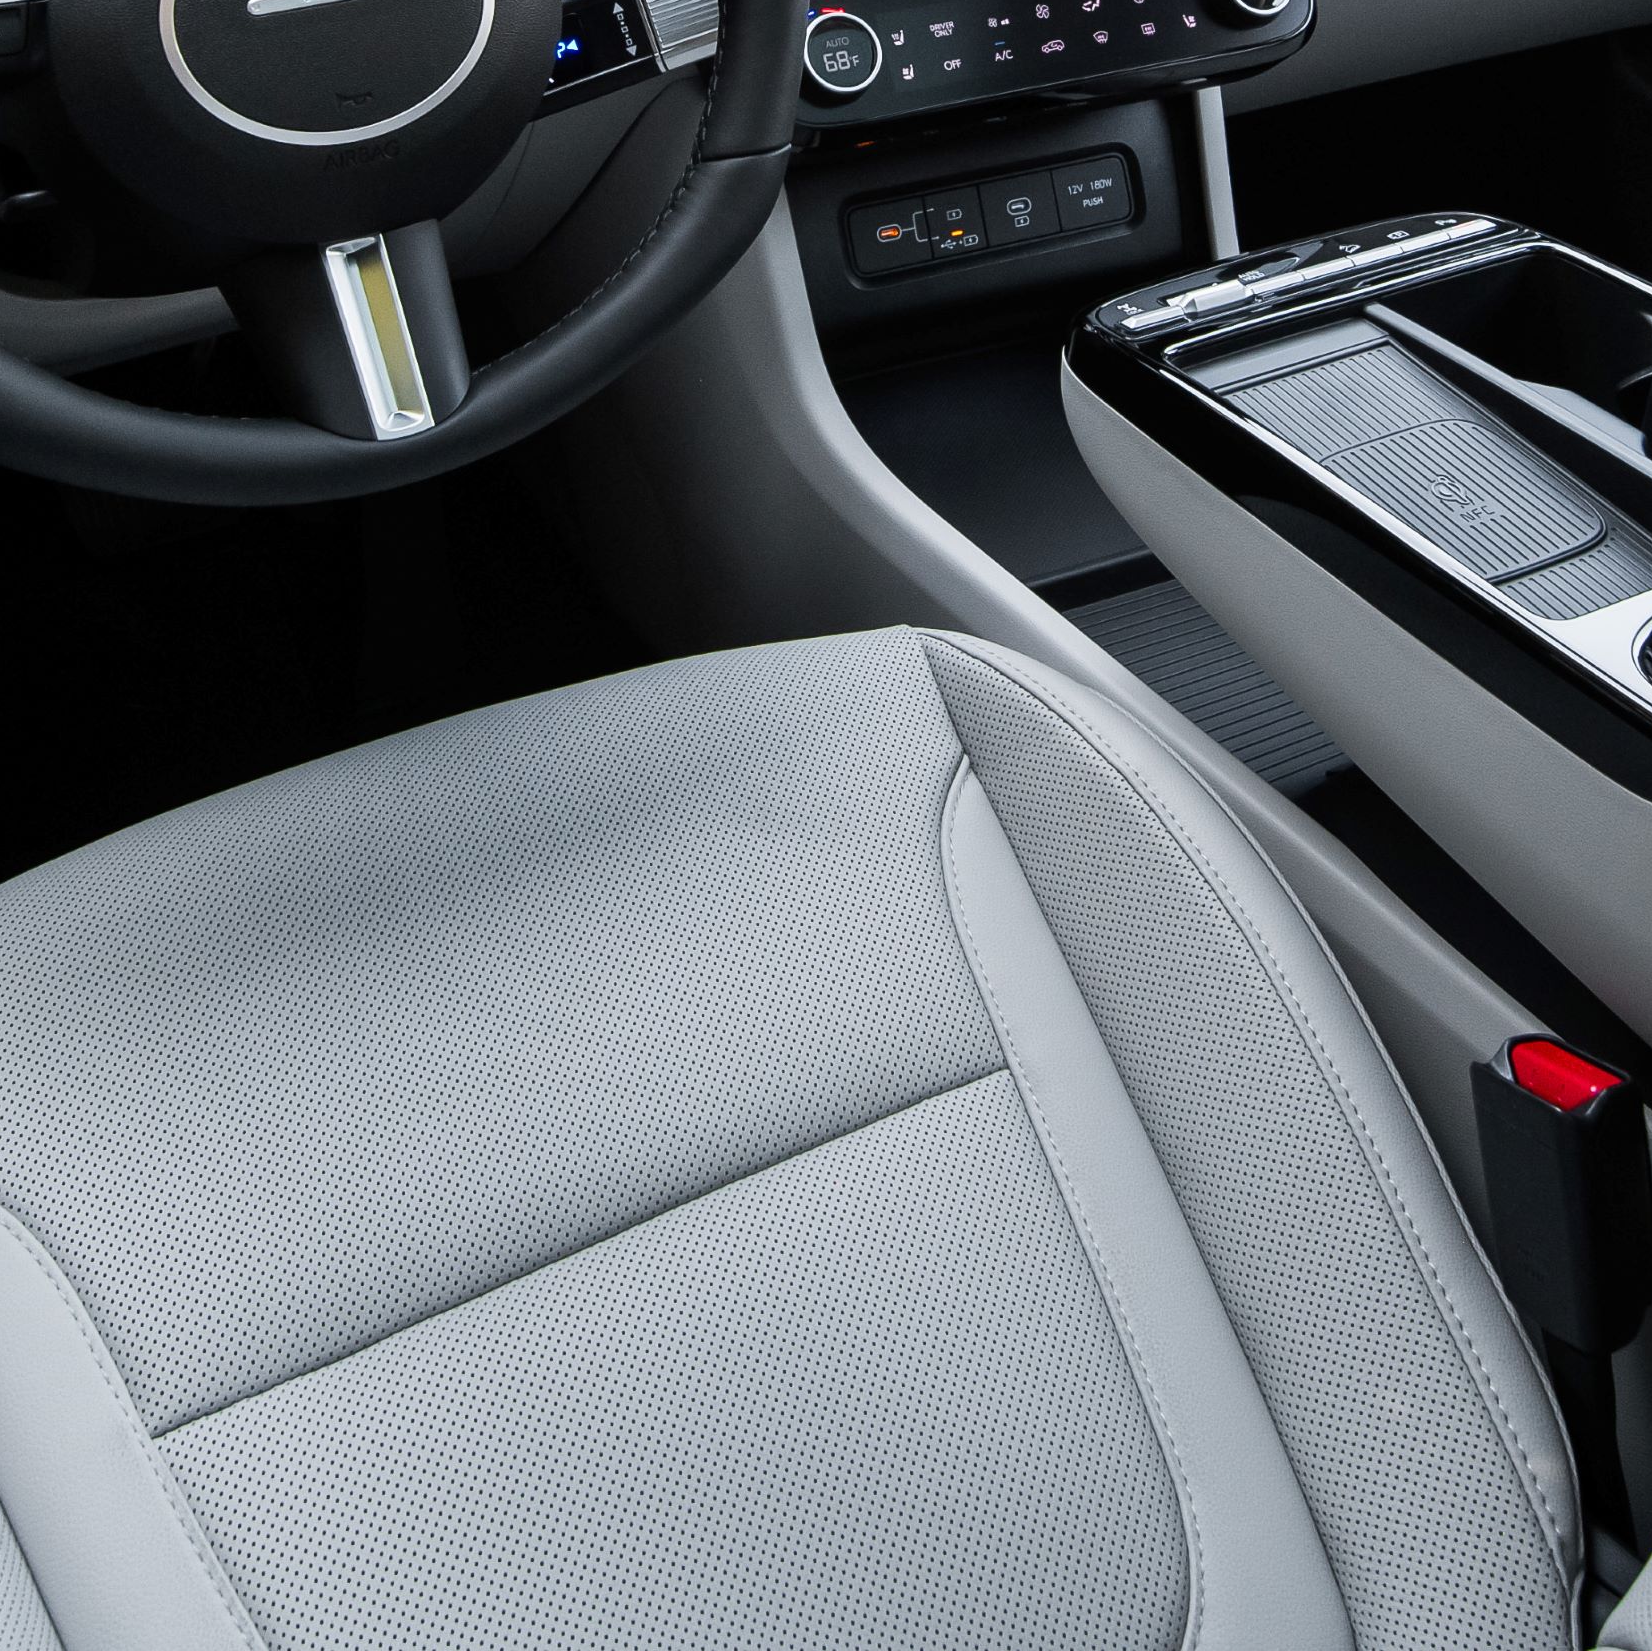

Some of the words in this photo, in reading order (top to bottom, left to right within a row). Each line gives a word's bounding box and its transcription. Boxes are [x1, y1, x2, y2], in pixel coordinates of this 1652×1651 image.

[929, 21, 955, 33] DRIVER
[934, 28, 954, 38] ONLY
[825, 37, 849, 49] AUTO
[994, 49, 1014, 62] A/C
[943, 58, 963, 71] OFF
[1067, 184, 1084, 196] 12V
[1089, 177, 1113, 192] 180W
[1083, 196, 1104, 208] PUSH
[1460, 505, 1495, 522] NFC
